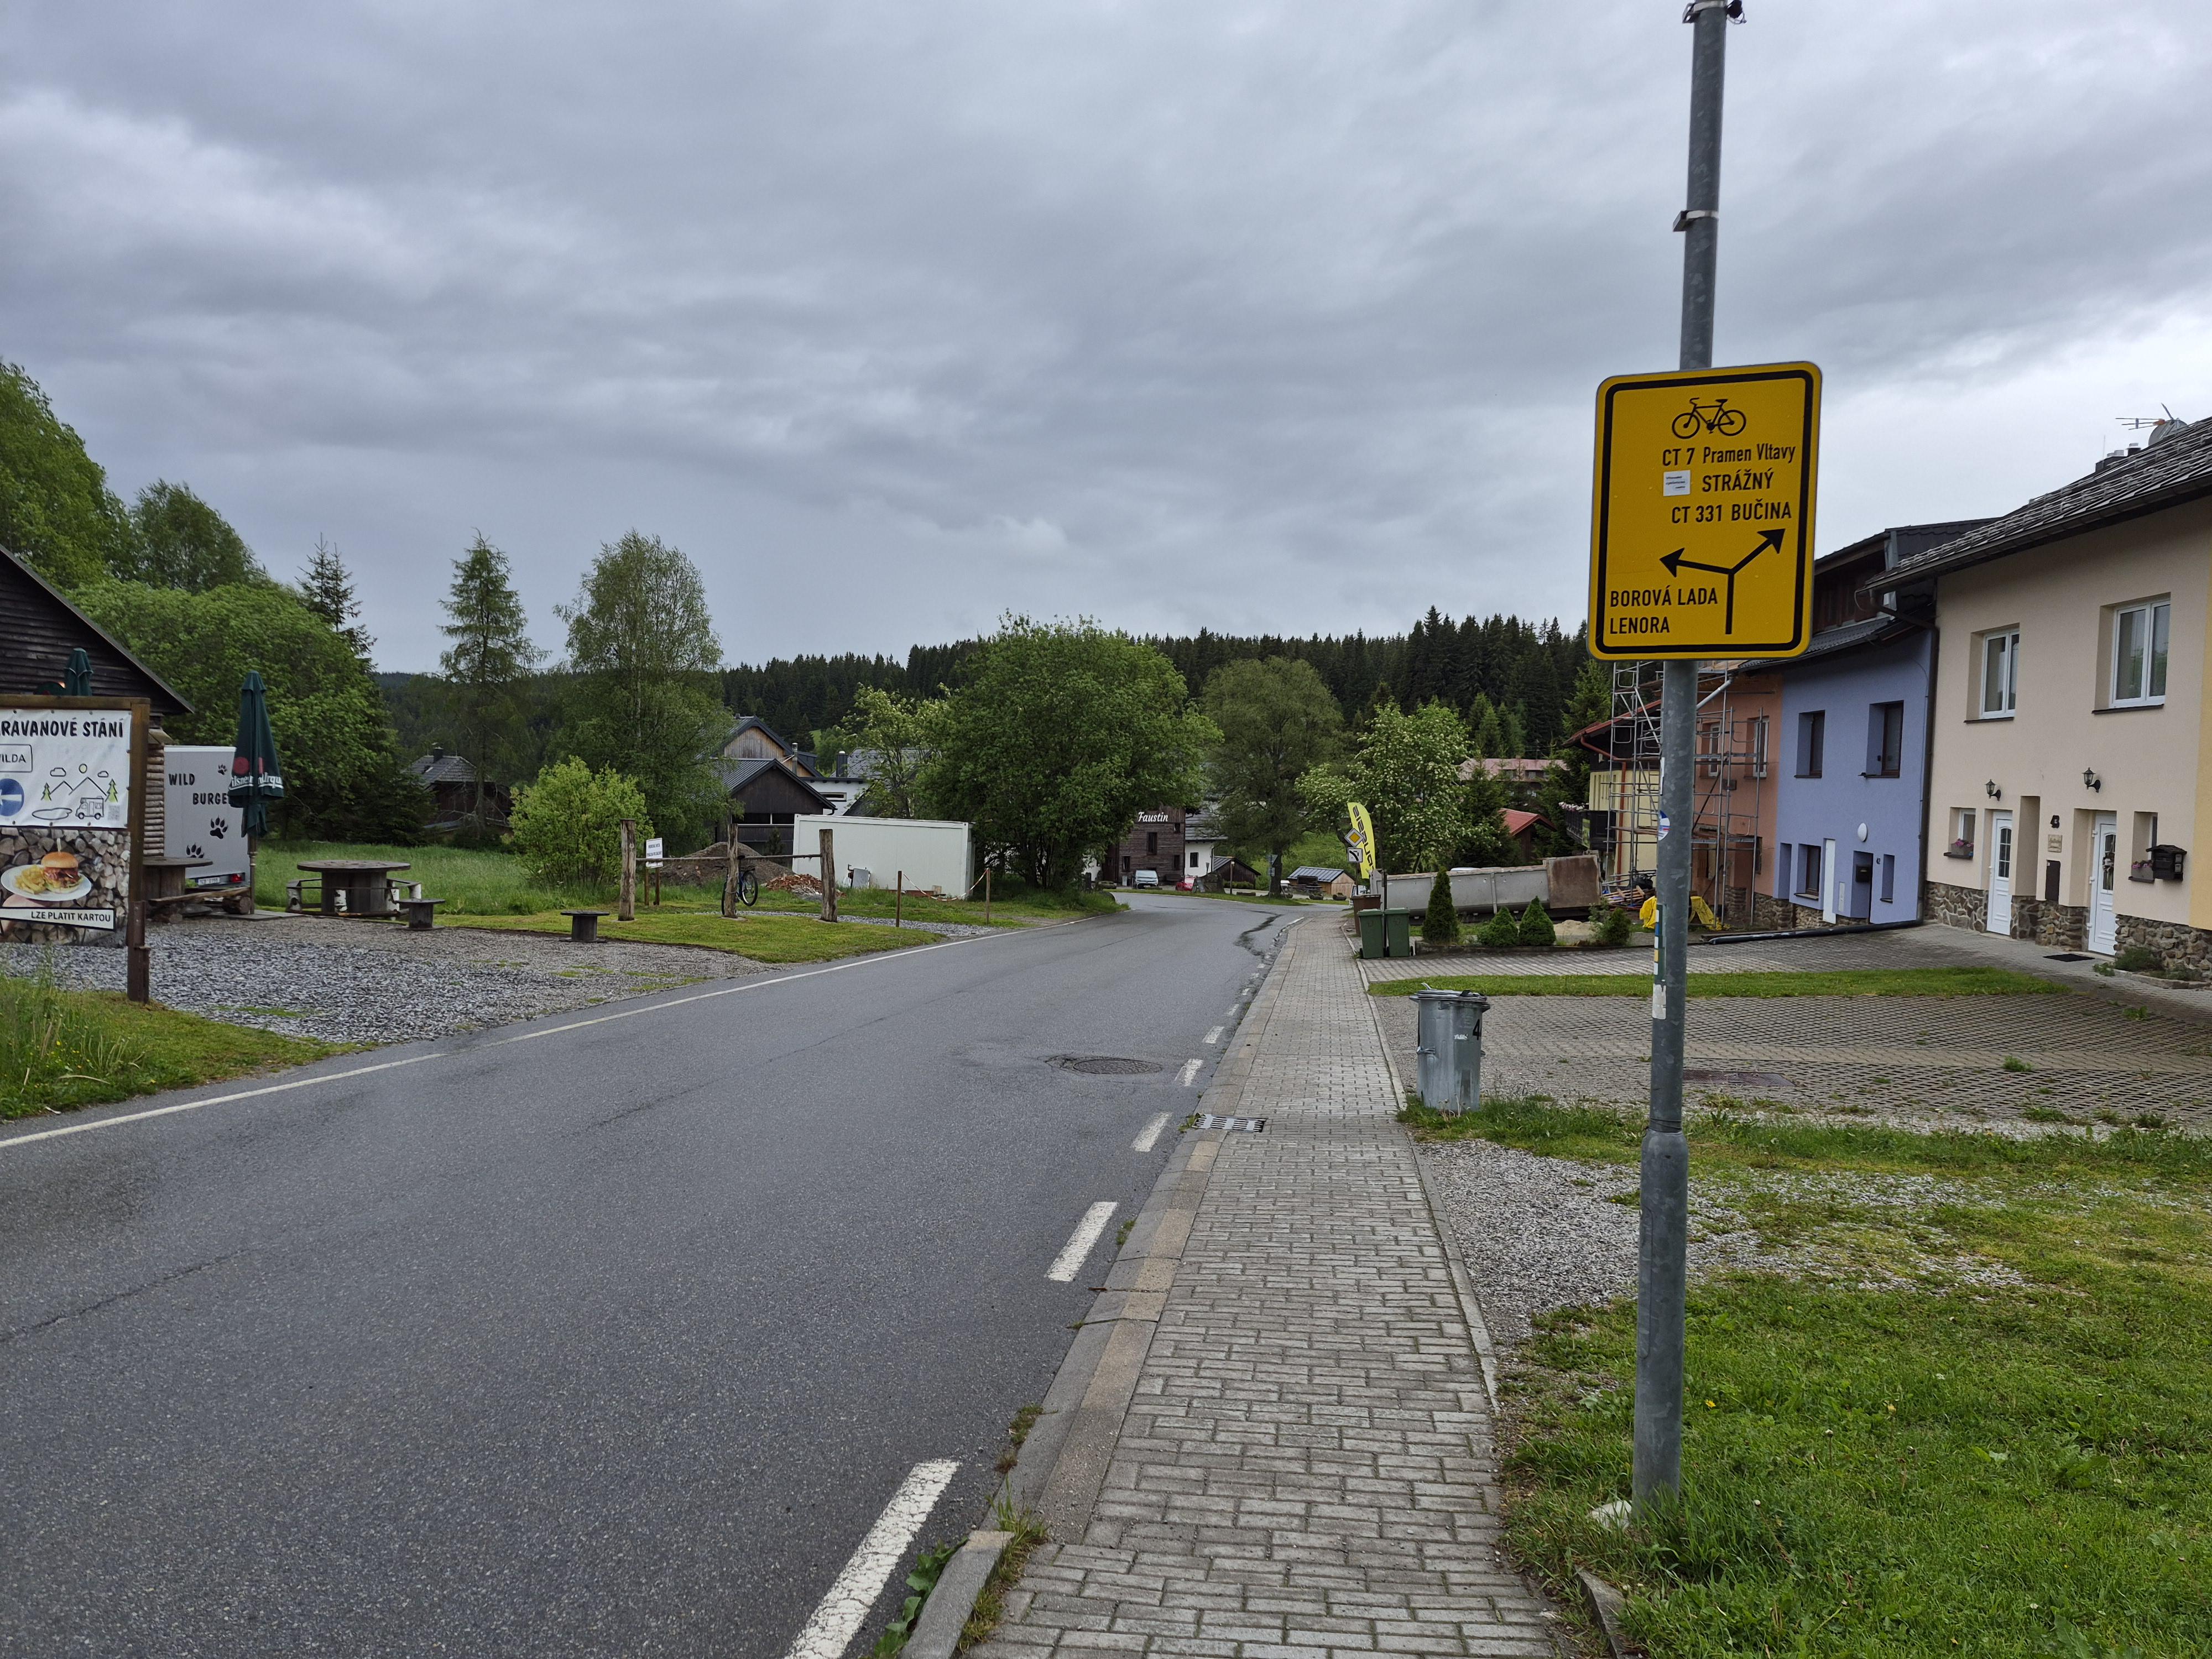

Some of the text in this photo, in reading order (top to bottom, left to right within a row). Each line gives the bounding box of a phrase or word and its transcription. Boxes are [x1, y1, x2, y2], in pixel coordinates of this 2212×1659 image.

[1662, 443, 1796, 466] CT 7 Pramen Vltavy
[1702, 467, 1774, 492] STRÁŽNÝ
[1672, 498, 1792, 524] CT 331 BUČINA
[1610, 585, 1718, 607] BOROVÁ LADA
[1610, 616, 1670, 634] LENORA
[0, 717, 123, 738] RAVANOVÉ STÁNÍ
[168, 773, 195, 786] WILD
[192, 792, 227, 805] BURGE
[1138, 811, 1168, 822] Faustin
[31, 911, 111, 922] LZE PLATIT KARTOU
